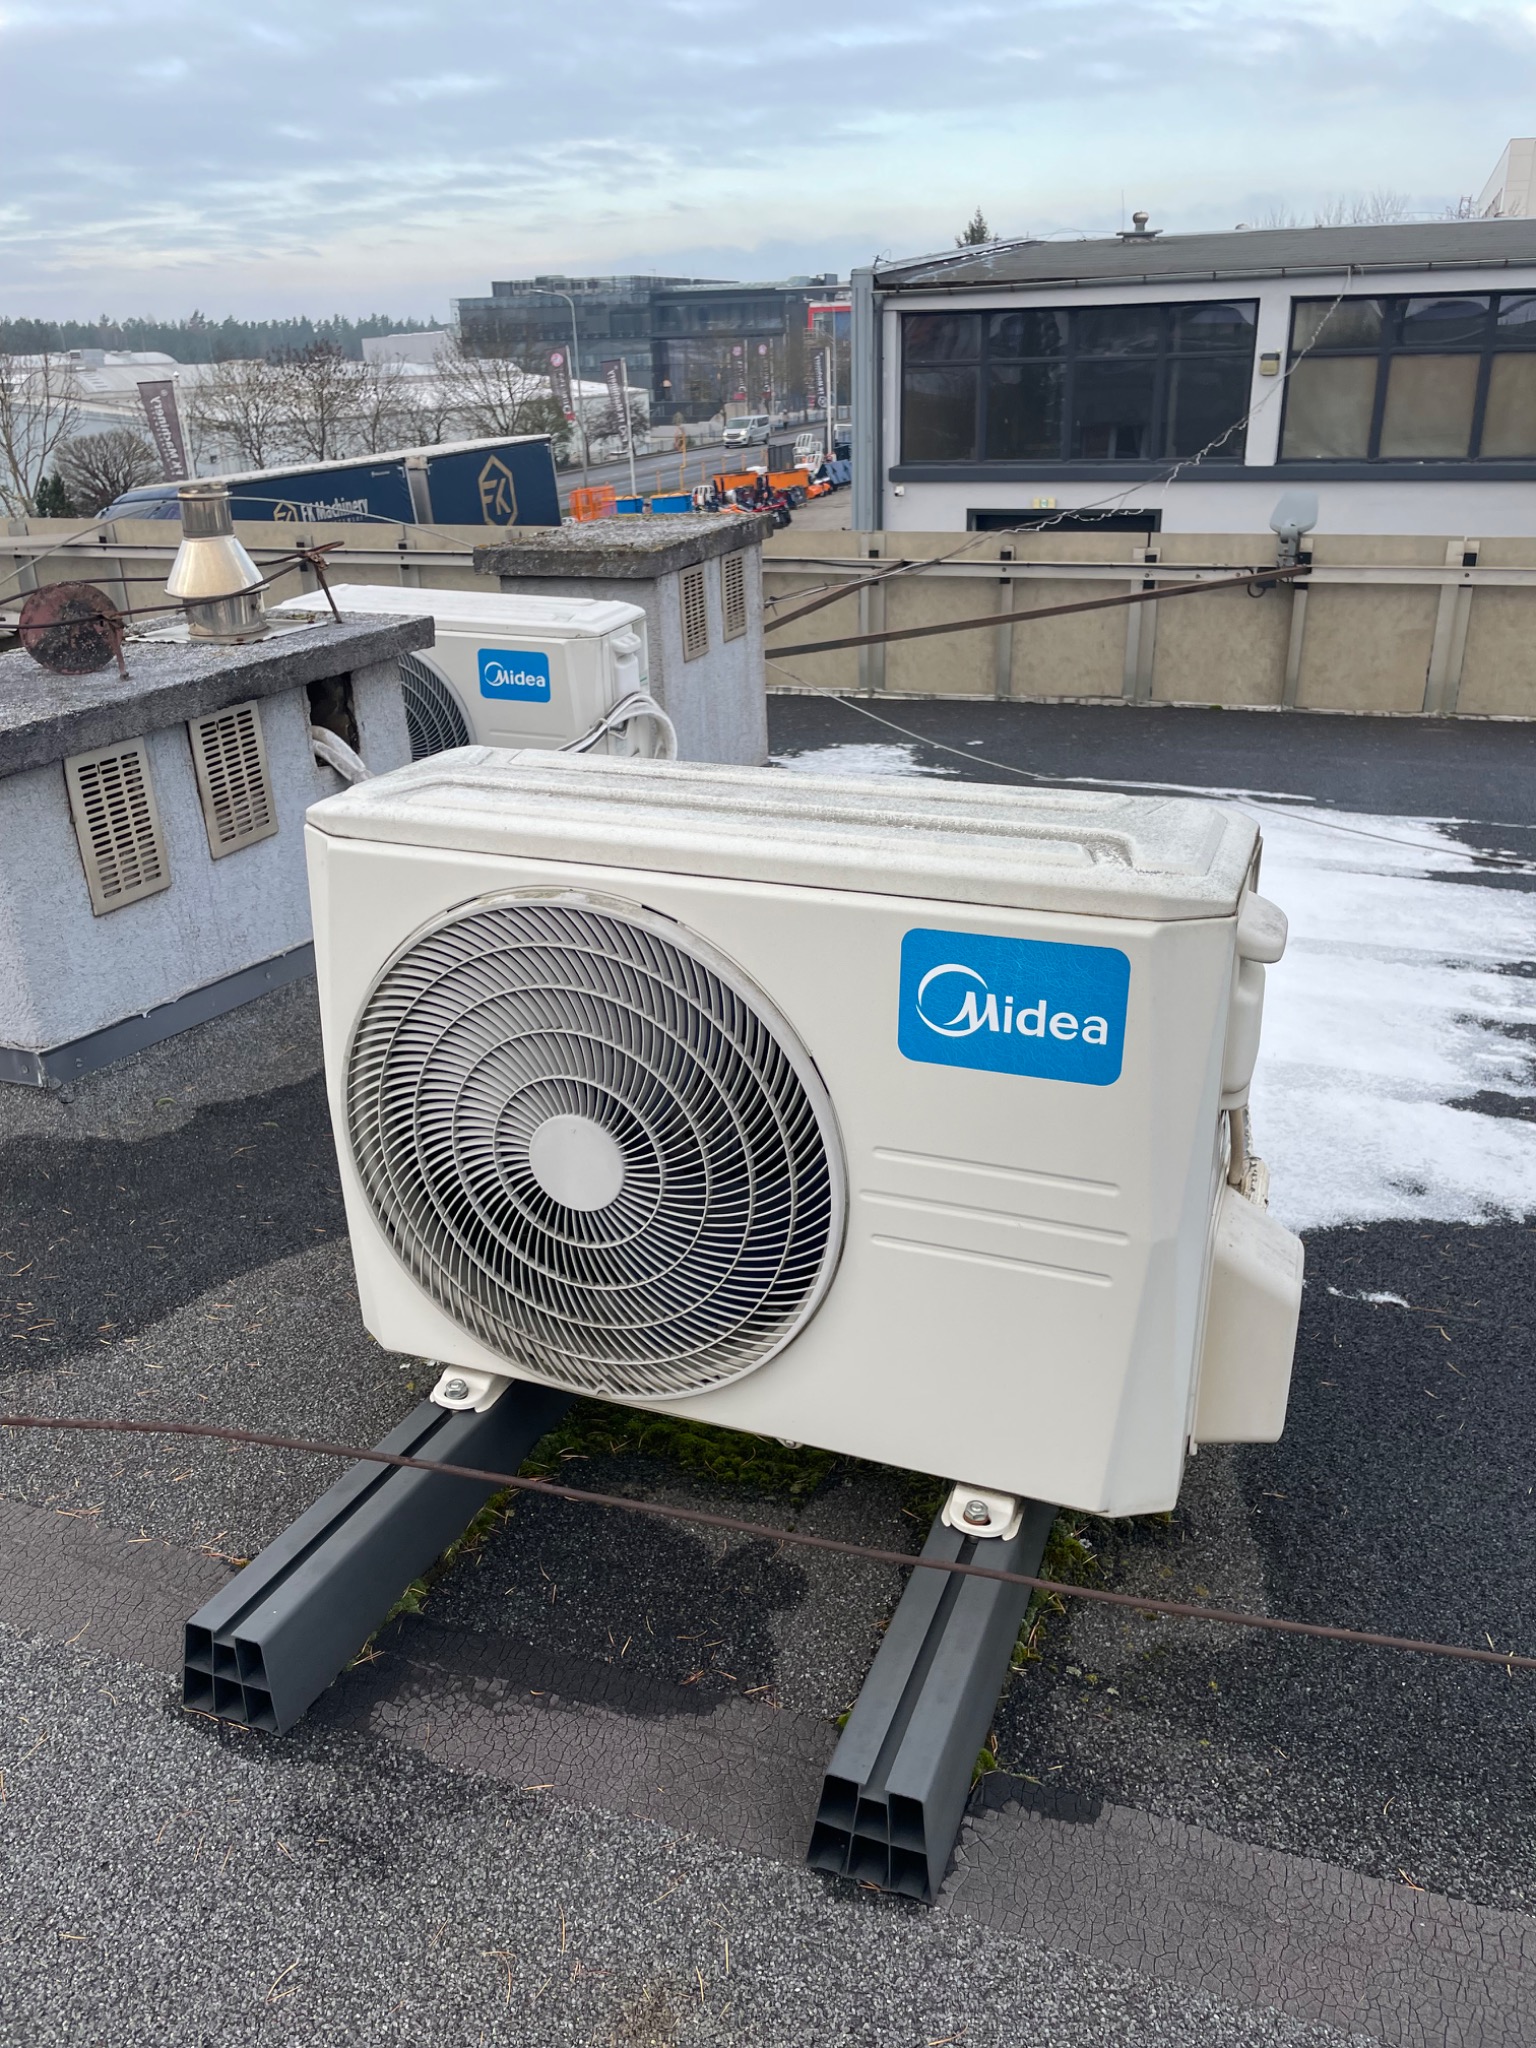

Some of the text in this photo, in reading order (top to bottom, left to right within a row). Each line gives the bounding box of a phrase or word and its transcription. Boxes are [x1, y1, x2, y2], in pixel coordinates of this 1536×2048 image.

[300, 503, 316, 522] FK
[315, 497, 369, 521] Machinery
[493, 669, 546, 688] Midea
[943, 991, 1108, 1045] Midea
